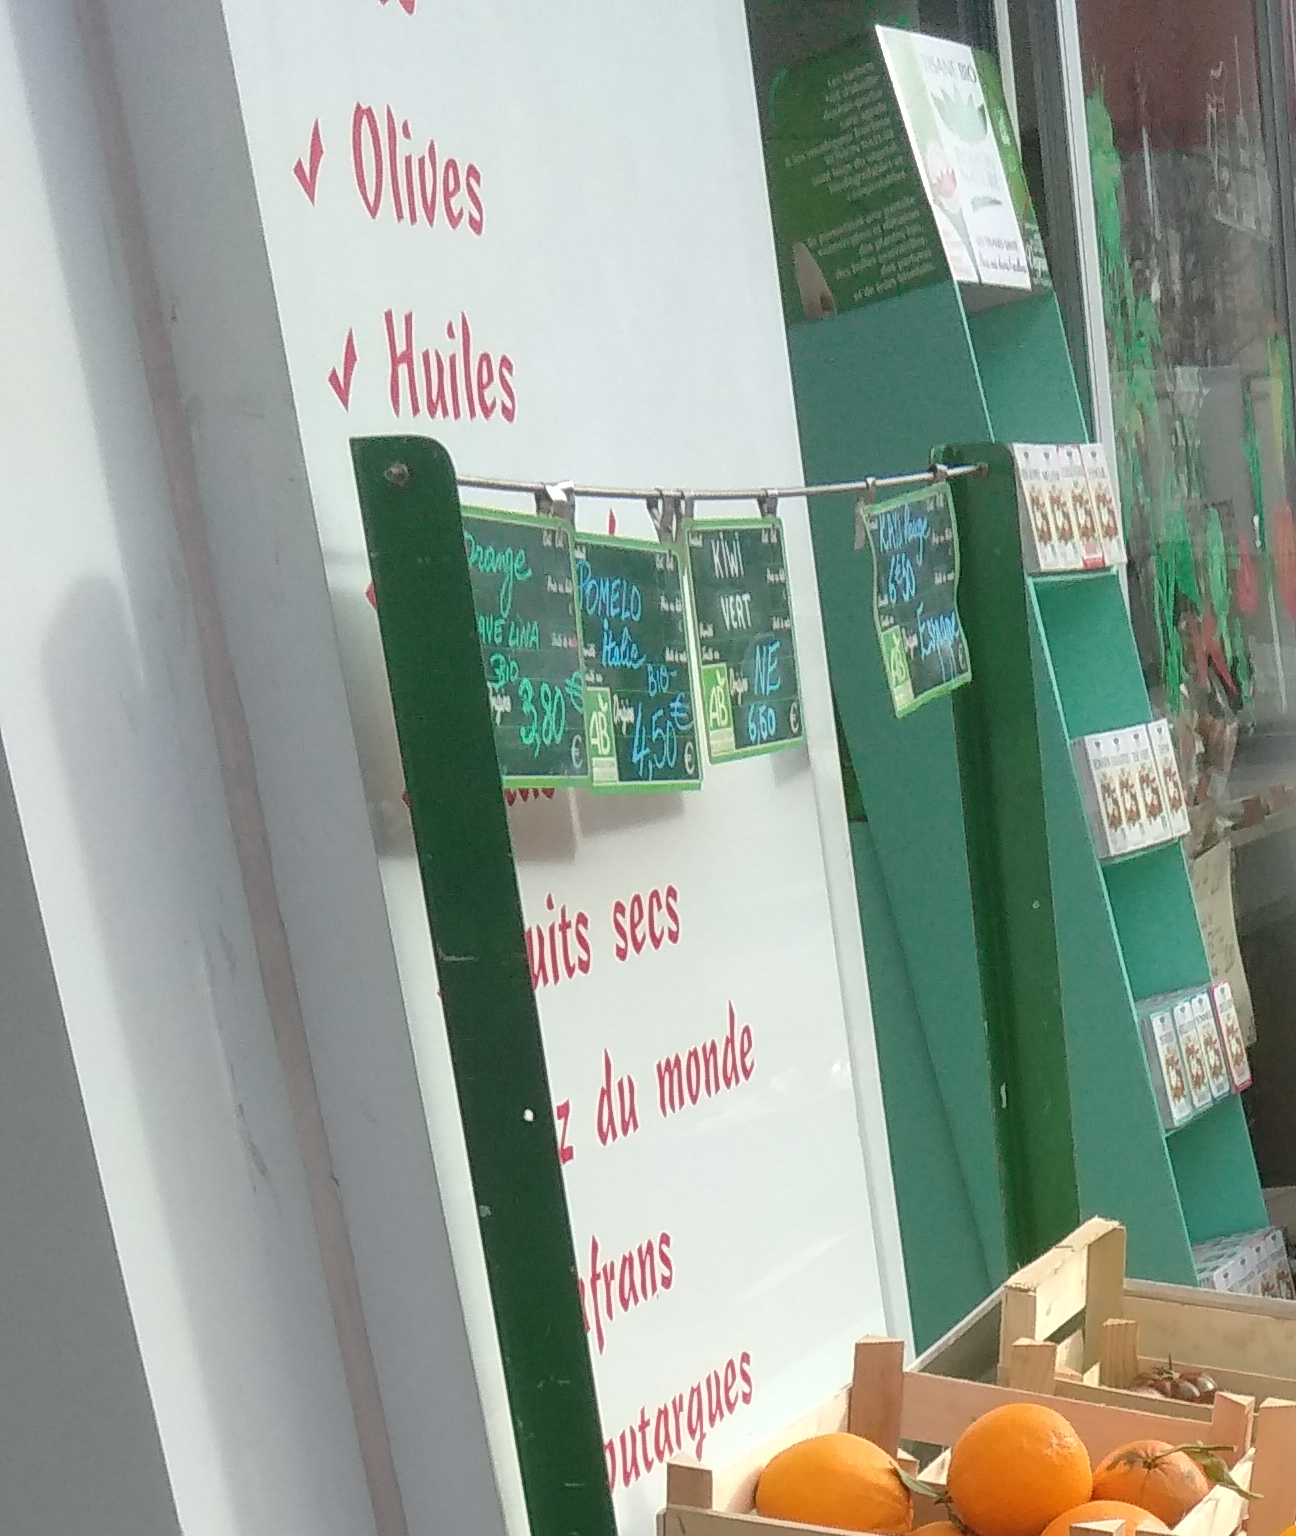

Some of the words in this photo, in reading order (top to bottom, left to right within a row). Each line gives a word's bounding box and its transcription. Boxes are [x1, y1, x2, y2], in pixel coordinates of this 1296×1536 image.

[351, 101, 484, 236] Olives
[384, 309, 517, 423] Huiles
[577, 560, 642, 621] POMELO
[720, 593, 752, 631] VERT
[525, 892, 592, 990] uits
[612, 884, 681, 962] secs
[596, 1047, 640, 1147] du
[655, 999, 755, 1119] monde
[579, 1233, 672, 1356] frans
[604, 1351, 754, 1496] outargues
